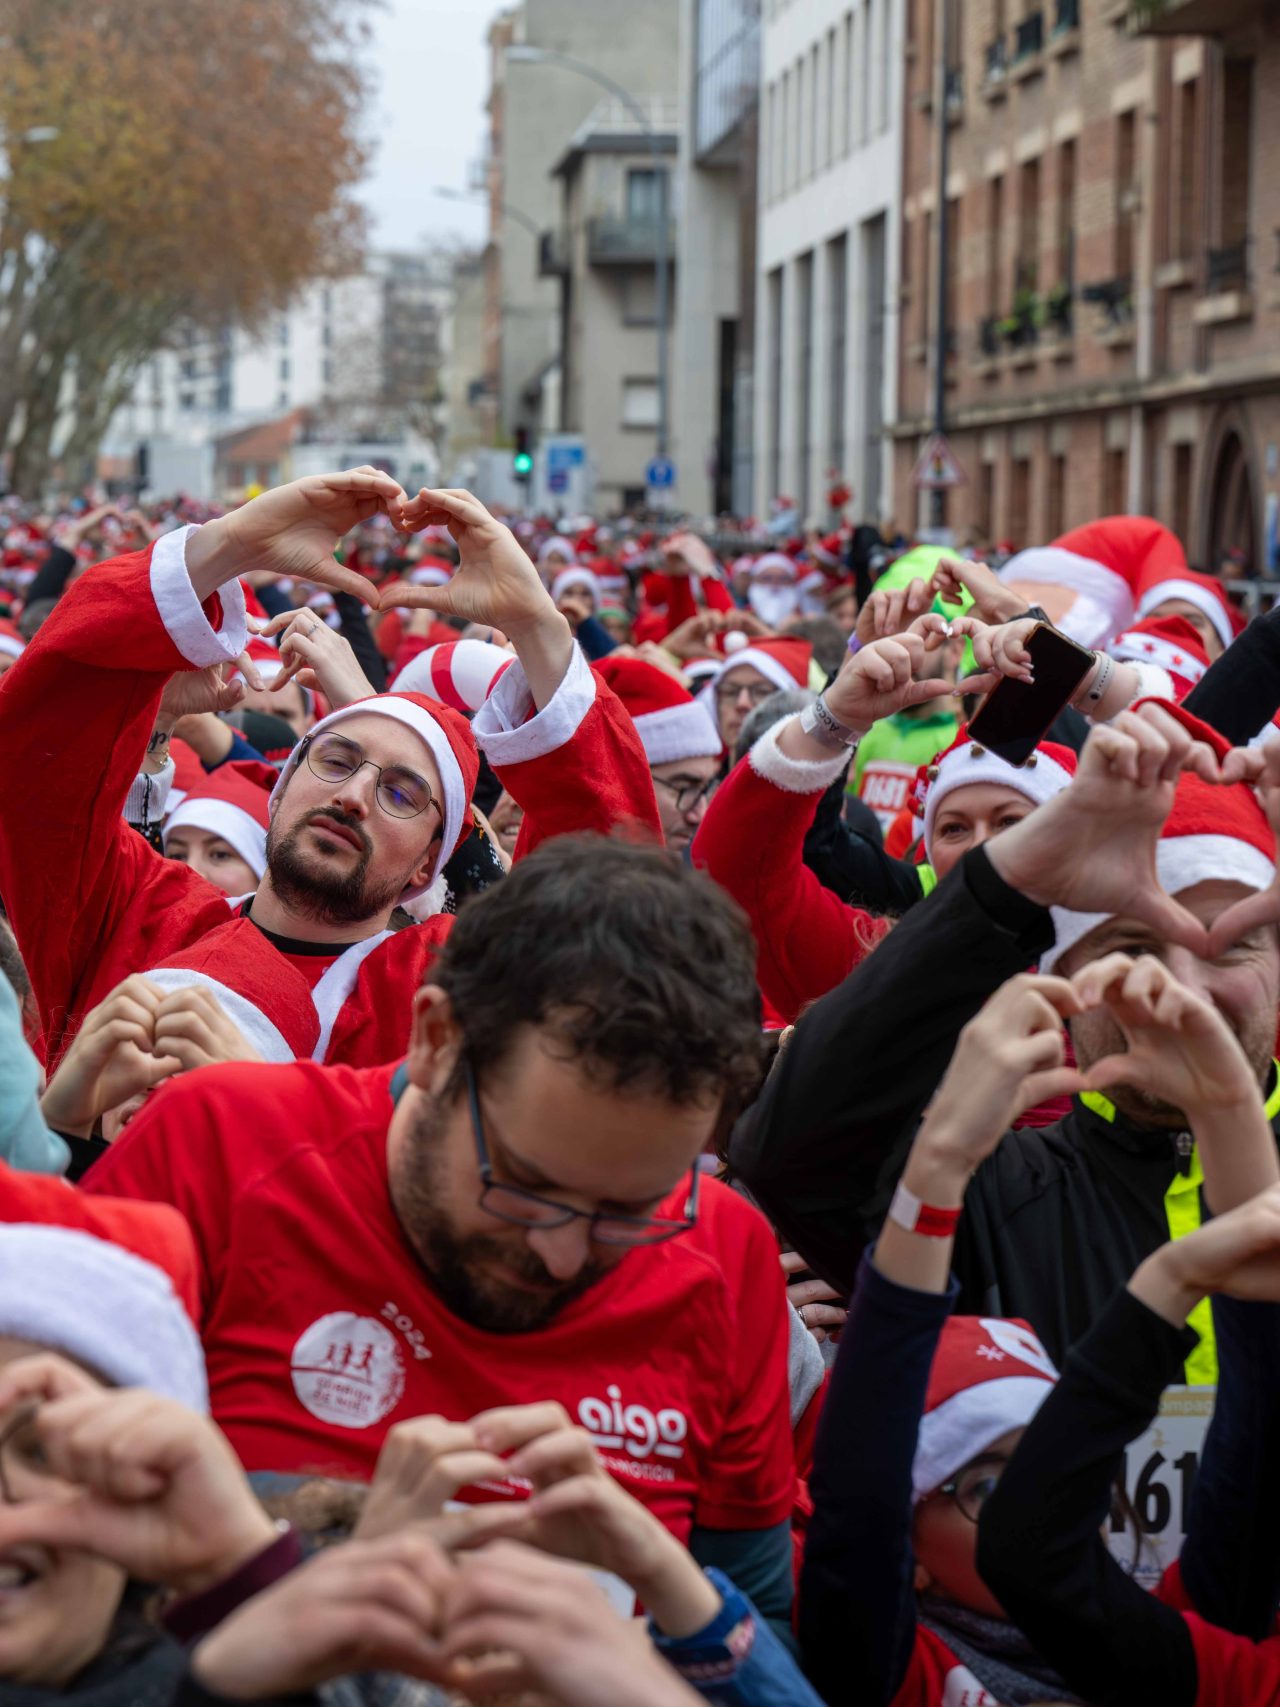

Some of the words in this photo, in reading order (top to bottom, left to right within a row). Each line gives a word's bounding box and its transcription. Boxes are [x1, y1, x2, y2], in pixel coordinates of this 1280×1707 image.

[816, 702, 840, 731] ACCO
[380, 1301, 433, 1360] 2024
[578, 1384, 687, 1458] aigo
